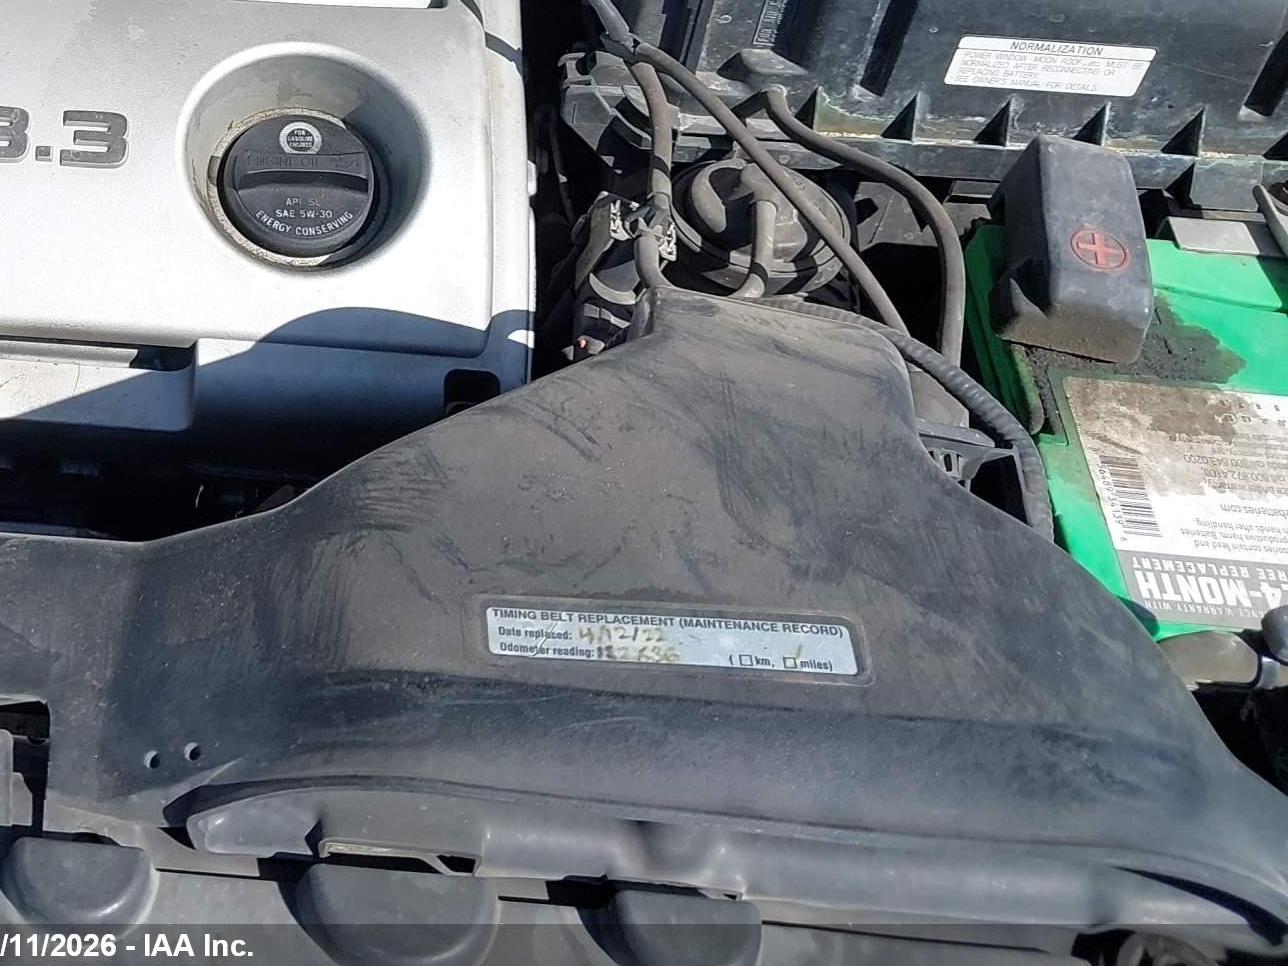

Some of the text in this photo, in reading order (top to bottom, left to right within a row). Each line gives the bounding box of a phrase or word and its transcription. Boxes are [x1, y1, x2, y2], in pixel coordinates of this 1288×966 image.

[1010, 41, 1104, 56] NORMALIZATION
[285, 198, 301, 206] API
[275, 209, 332, 218] SAE 5W-30
[255, 210, 353, 236] ENERGY CONSERVING
[1132, 556, 1251, 578] REPLACEMENT
[1144, 600, 1172, 611] WITH
[1176, 602, 1234, 617] WARRANTY
[492, 608, 844, 639] TIMING BELT REPLACEMENT (MAINTENANCE RECORD)
[498, 626, 572, 641] Date replaced:
[499, 642, 595, 659] Odometer reading:
[800, 660, 833, 672] miles)
